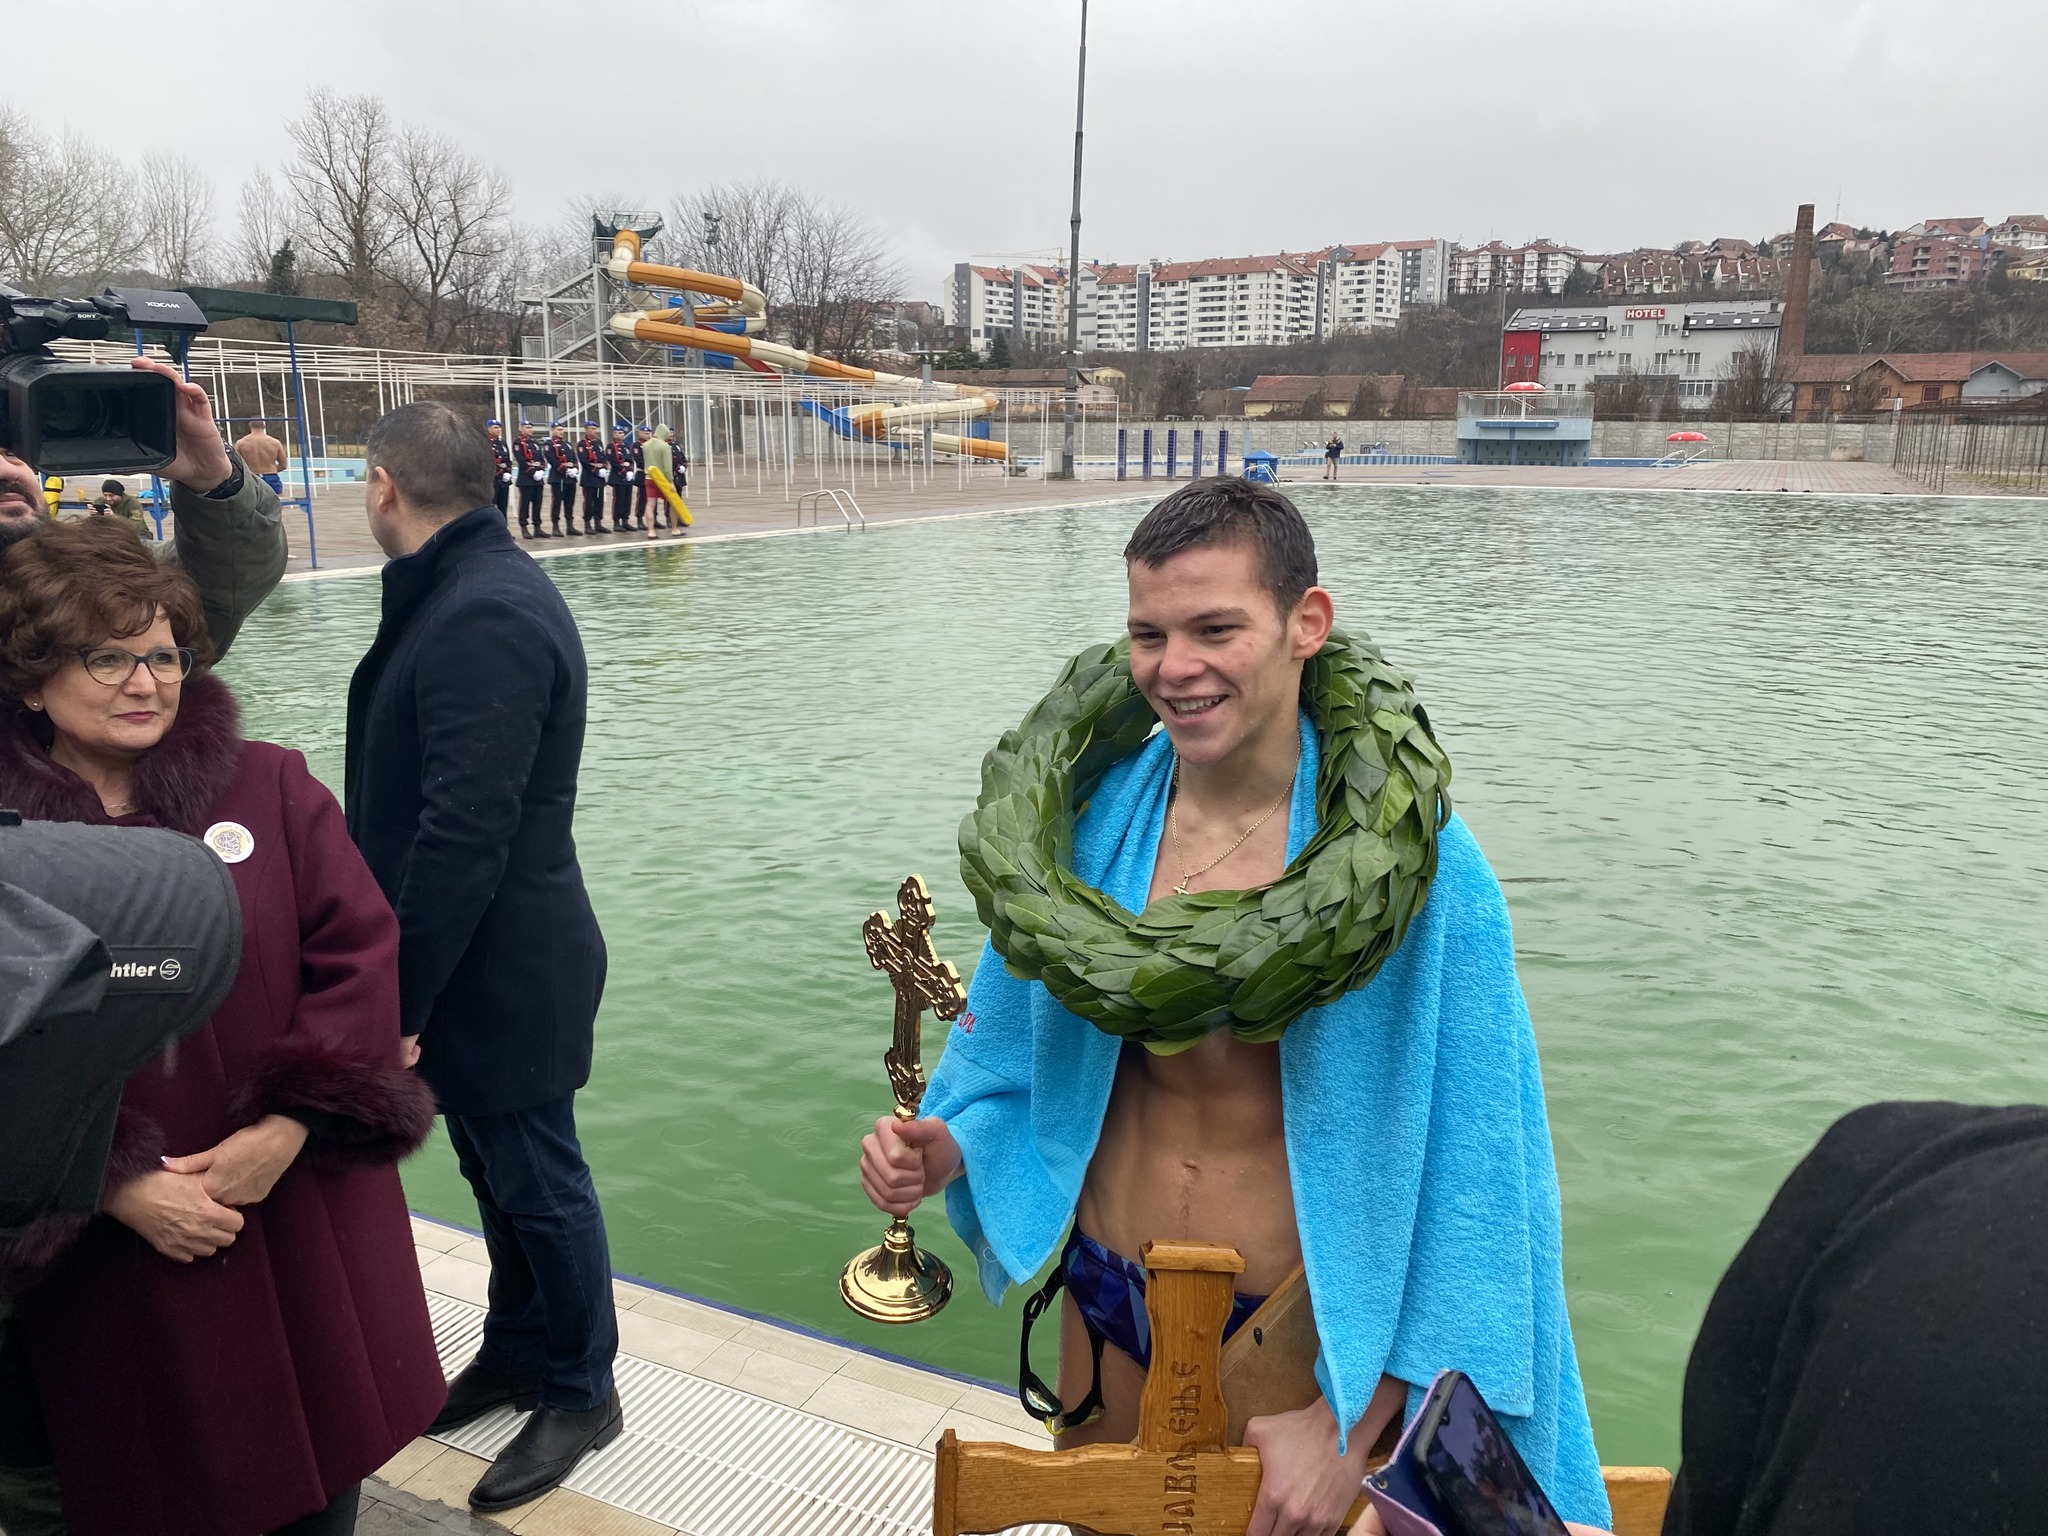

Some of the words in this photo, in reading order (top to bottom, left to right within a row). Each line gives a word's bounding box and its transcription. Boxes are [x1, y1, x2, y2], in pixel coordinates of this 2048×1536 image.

[145, 301, 180, 309] XDCAM
[1626, 309, 1664, 318] HOTEL
[110, 962, 157, 978] htler
